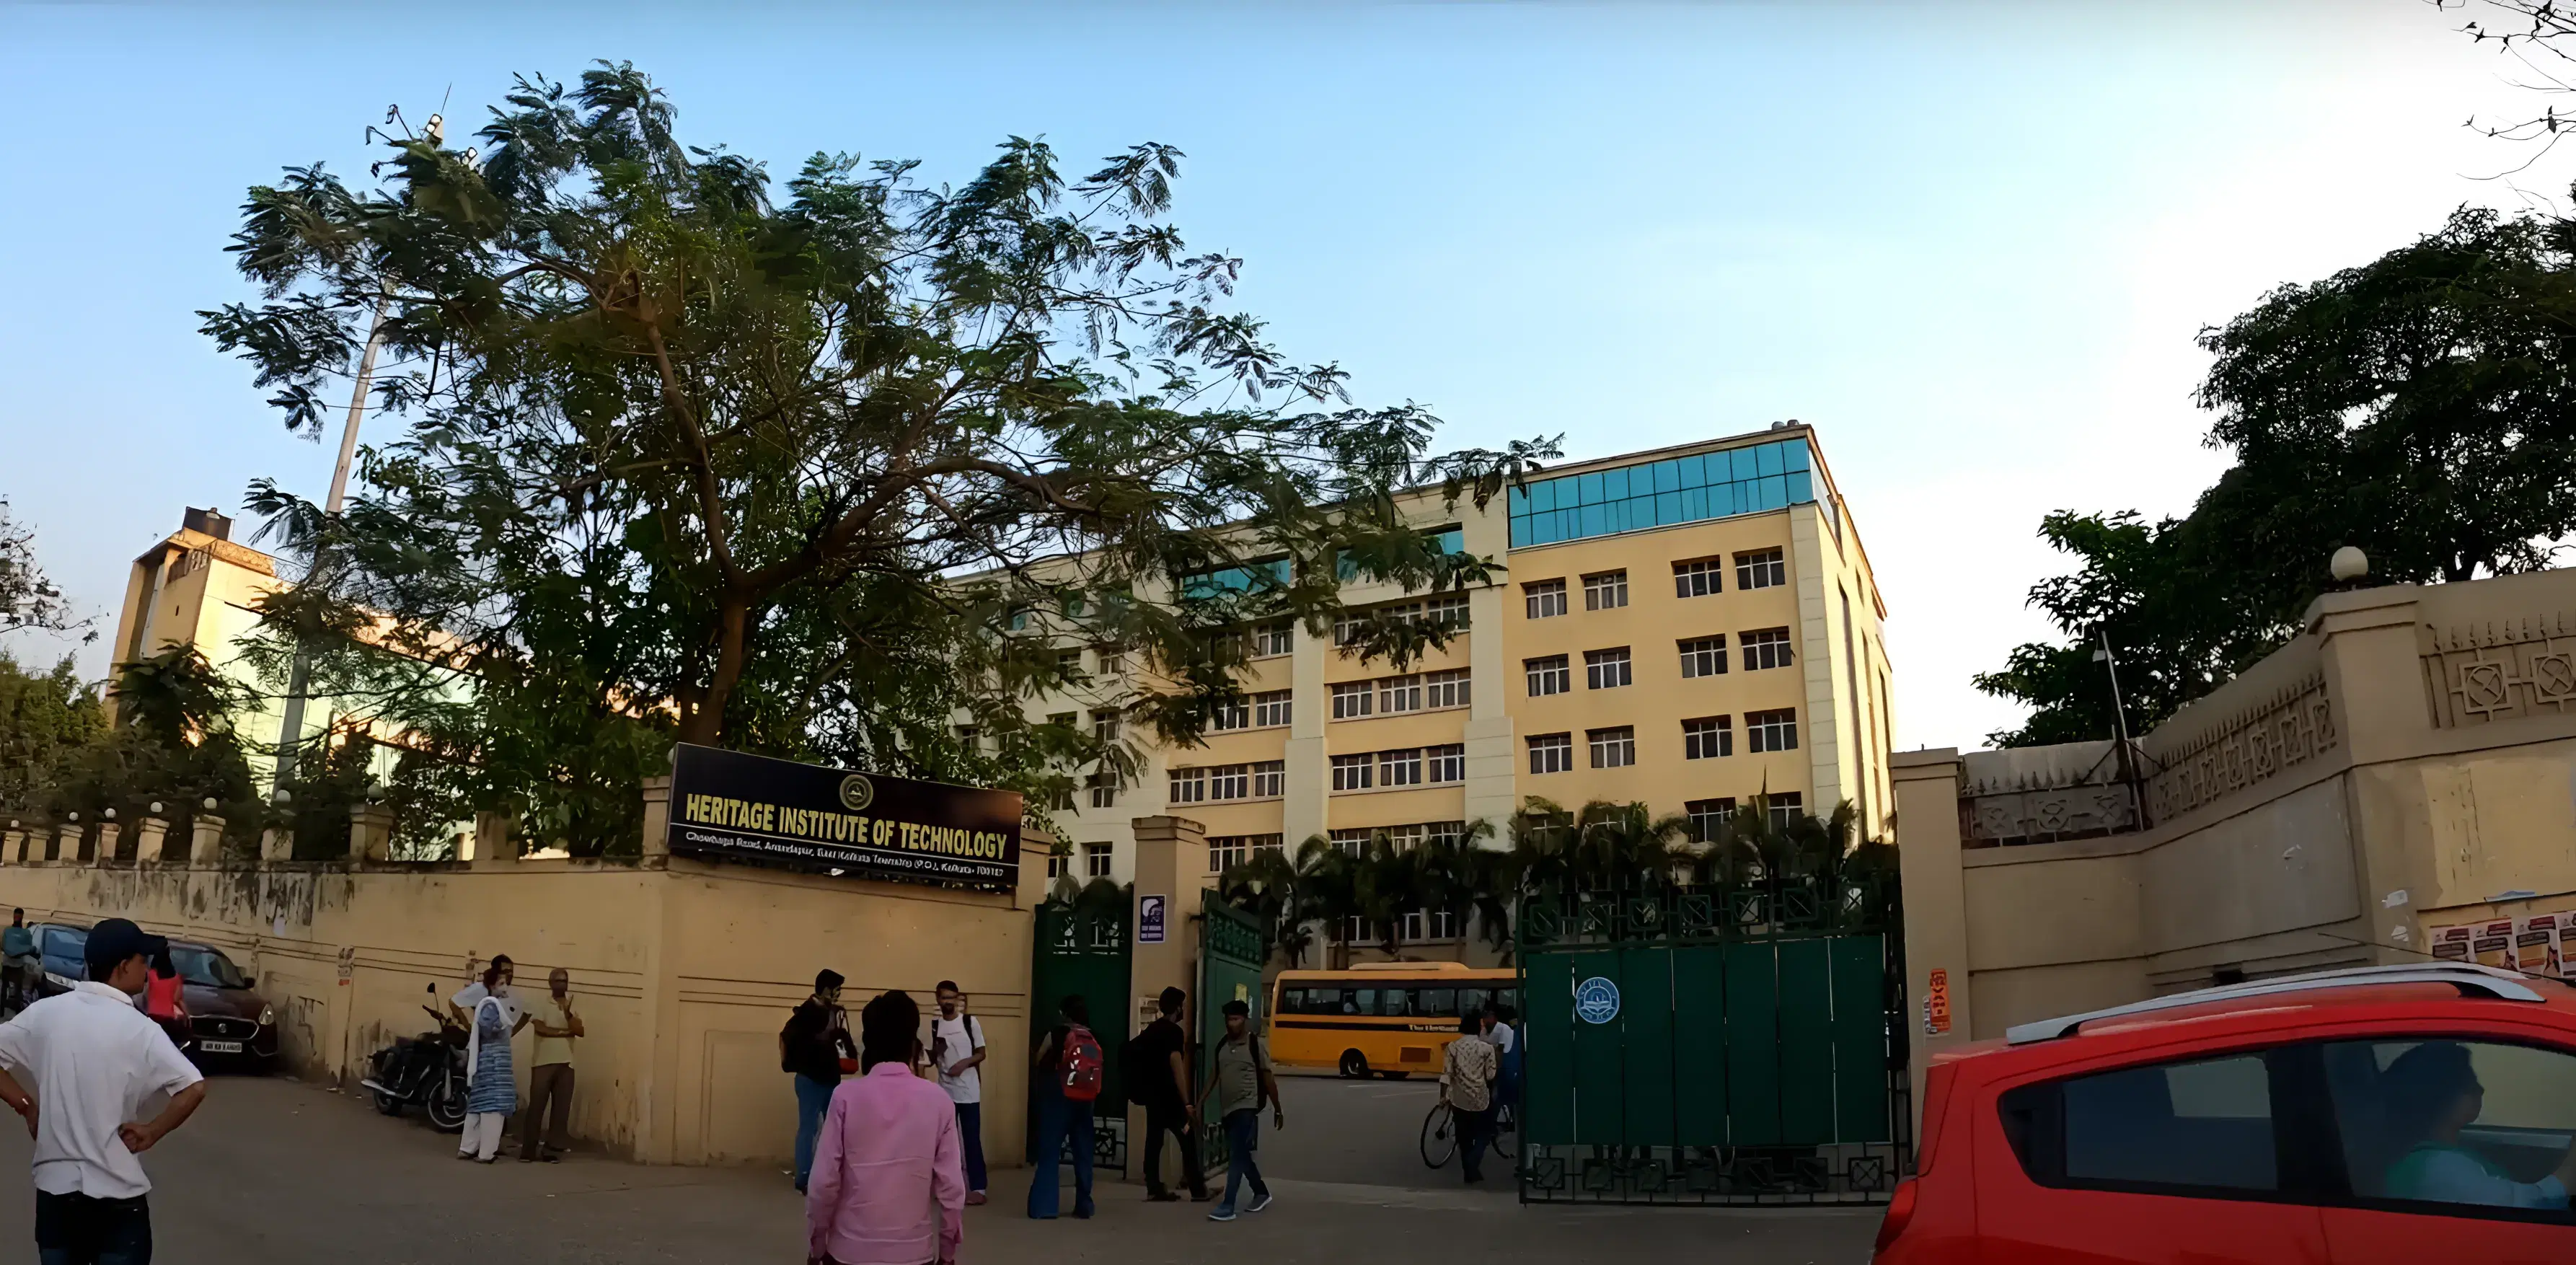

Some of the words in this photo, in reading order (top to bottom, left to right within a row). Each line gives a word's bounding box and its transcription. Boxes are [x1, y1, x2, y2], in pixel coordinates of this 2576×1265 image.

[686, 793, 775, 832] HERITAGE
[779, 806, 869, 843] INSTITUTE
[873, 819, 895, 847] OF
[899, 821, 1007, 860] TECHNOLOGY
